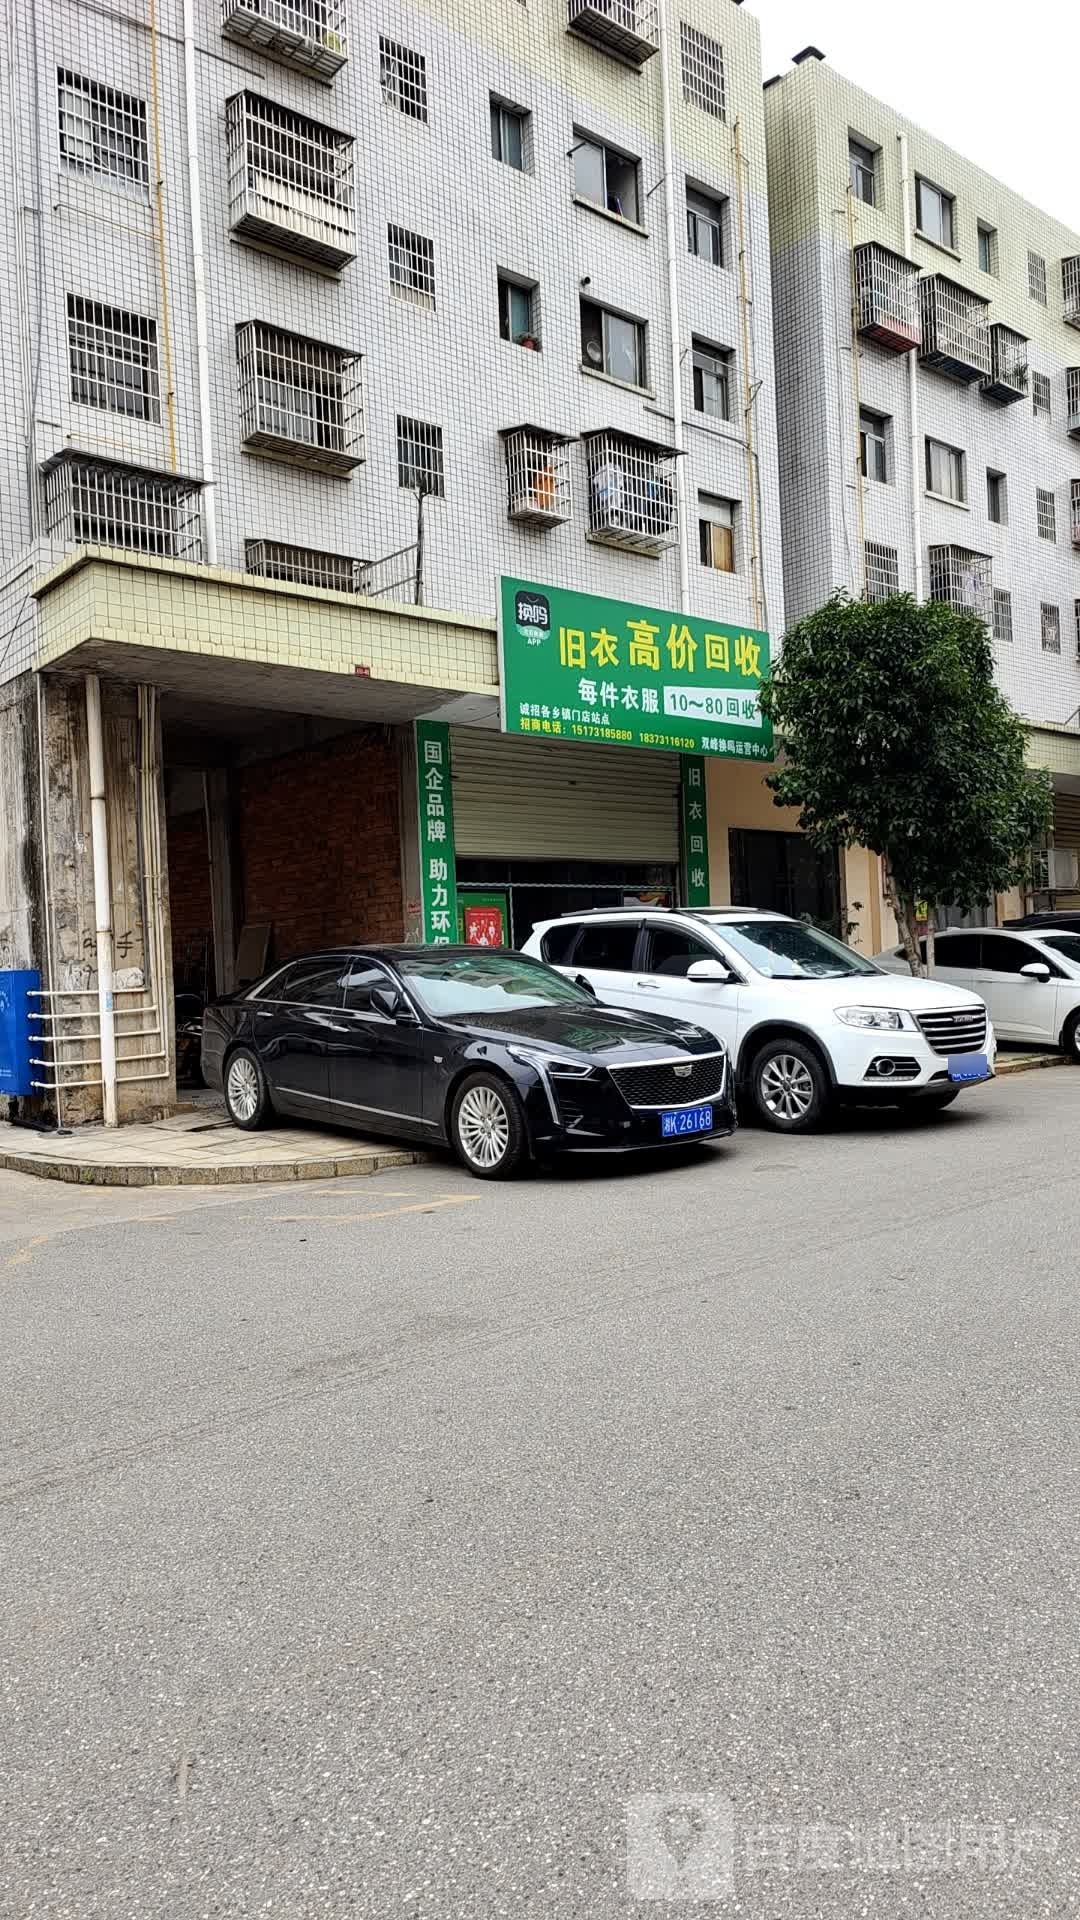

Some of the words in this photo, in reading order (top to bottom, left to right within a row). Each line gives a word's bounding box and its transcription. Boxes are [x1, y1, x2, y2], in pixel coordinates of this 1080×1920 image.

[527, 637, 542, 646] APP
[558, 619, 763, 678] 旧衣高价回收
[519, 702, 610, 726] 诚招各乡镇门店站点
[577, 678, 660, 715] 每件衣服
[571, 724, 633, 741] 15173185880
[639, 732, 695, 749] 18373116120
[423, 740, 447, 843] 国企品牌
[688, 767, 706, 889] 旧衣回收
